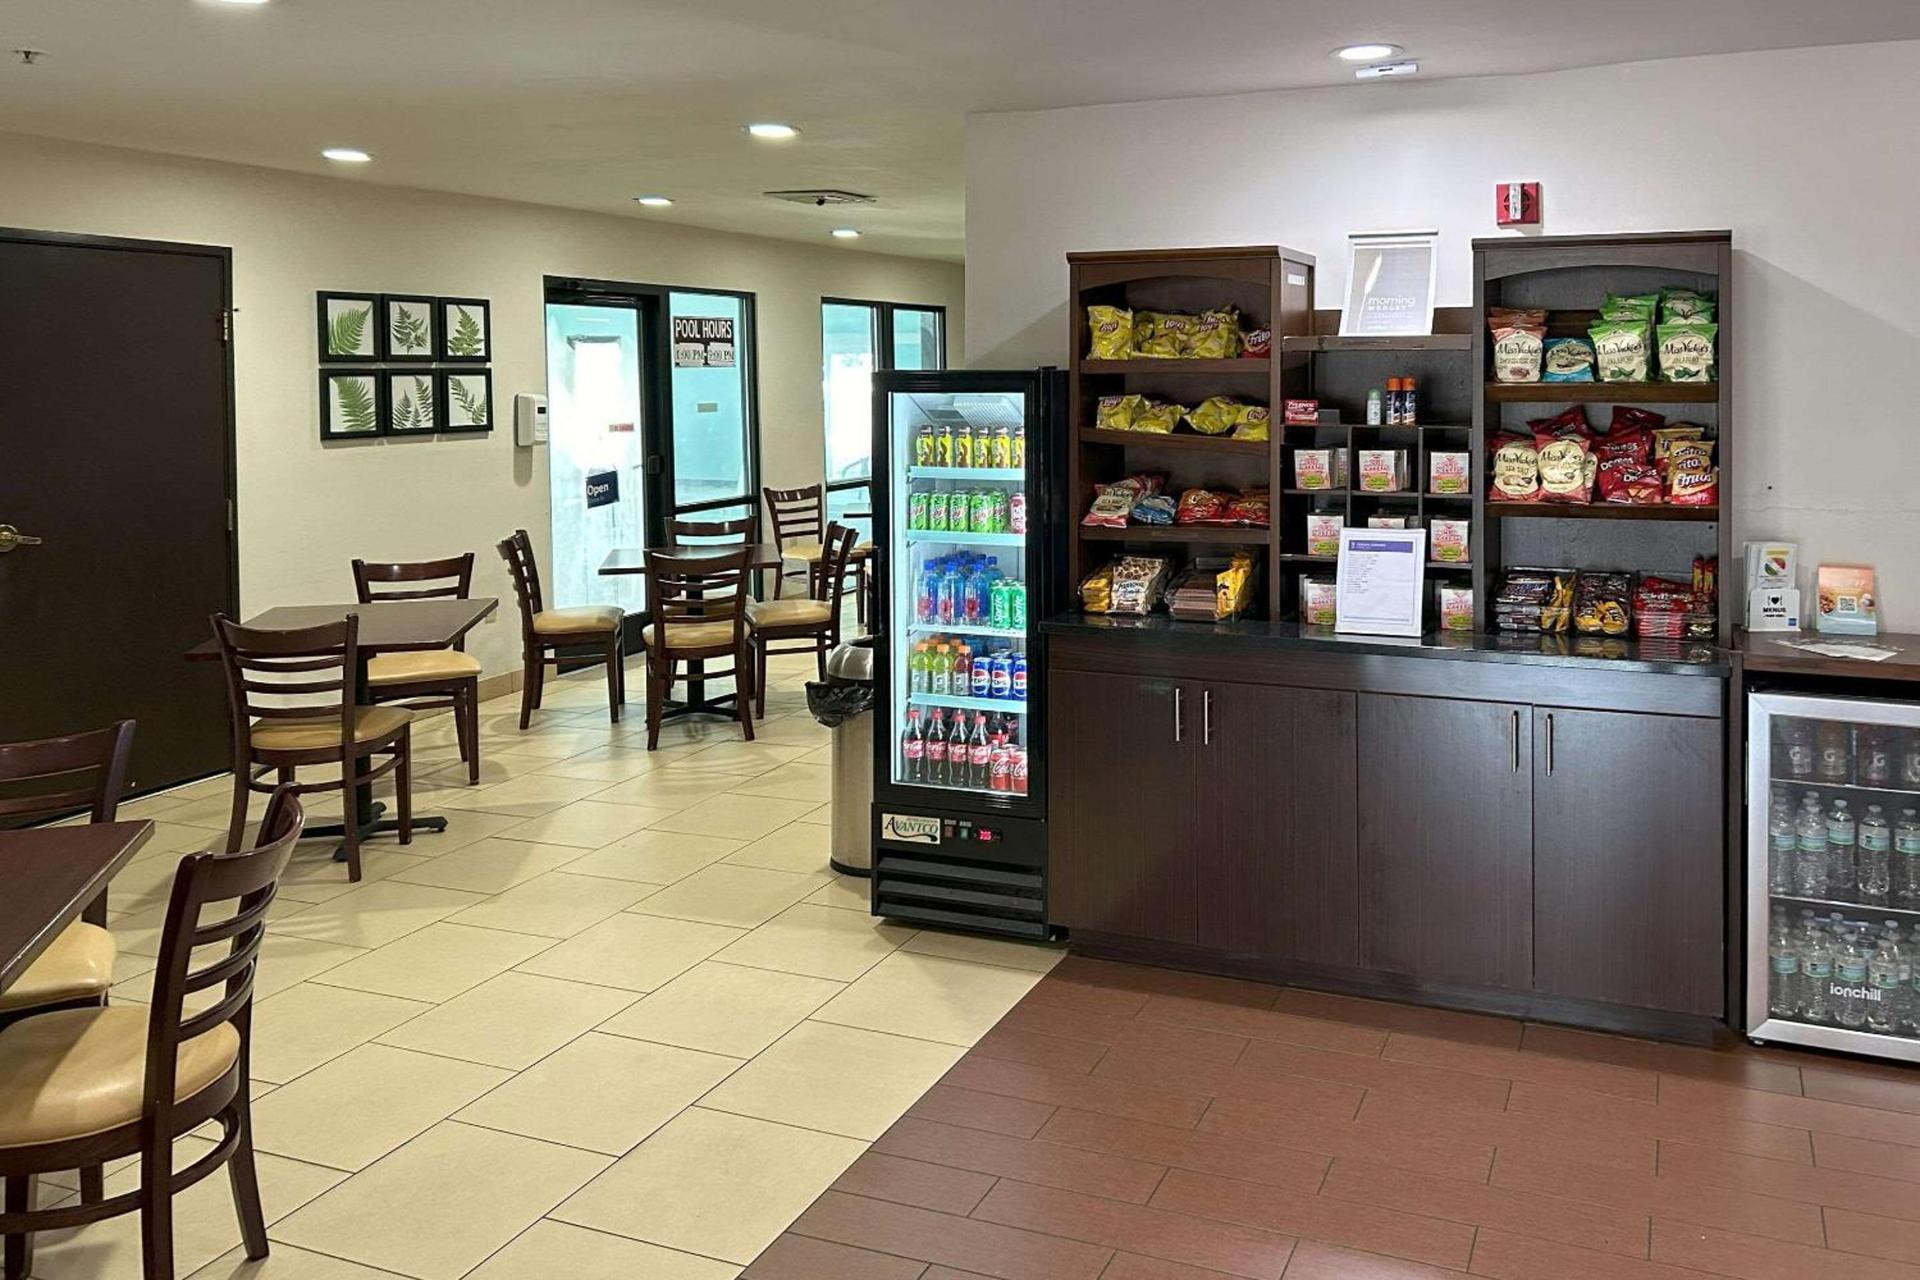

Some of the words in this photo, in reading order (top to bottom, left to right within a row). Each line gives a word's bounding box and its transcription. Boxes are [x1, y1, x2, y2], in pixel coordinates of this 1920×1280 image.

[1368, 295, 1416, 307] morning
[675, 319, 701, 339] POOL
[702, 320, 732, 339] HOURS
[587, 483, 609, 497] Open
[884, 815, 939, 835] AVANTCO
[1829, 982, 1881, 1001] ionchill
